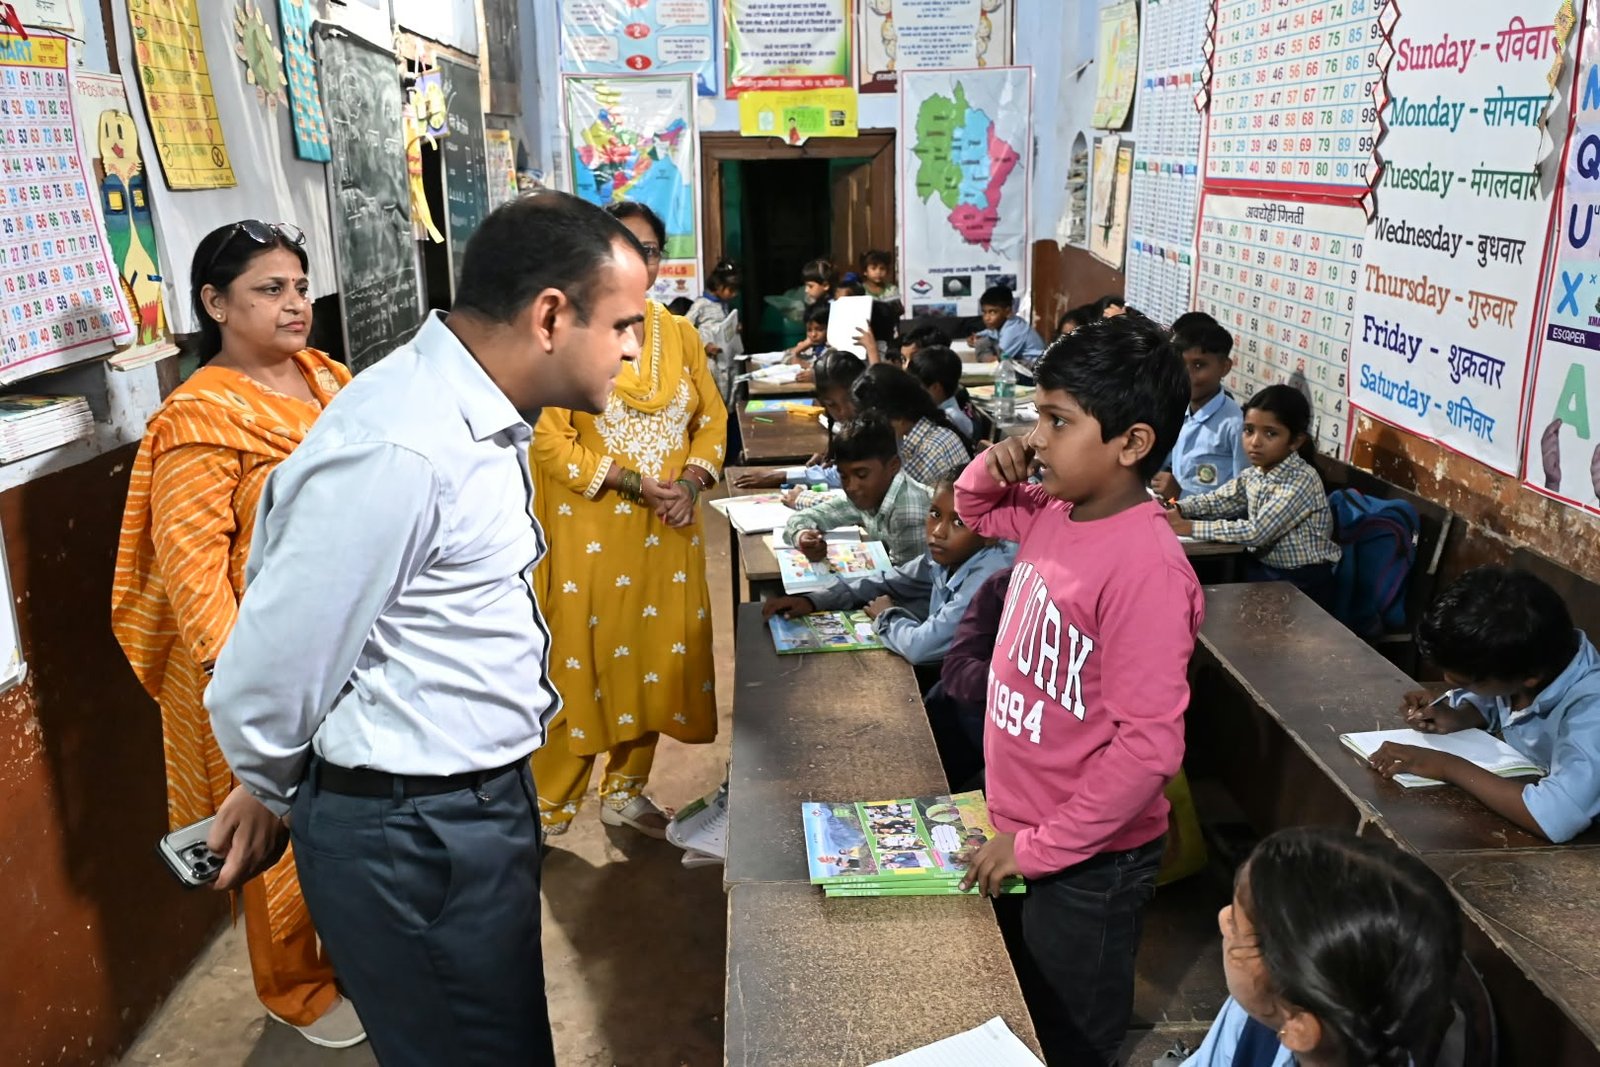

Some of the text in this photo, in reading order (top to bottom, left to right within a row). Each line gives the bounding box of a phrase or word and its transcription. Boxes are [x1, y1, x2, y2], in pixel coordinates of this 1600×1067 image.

[1277, 1, 1365, 31] 44 54 64 74 84
[1275, 28, 1362, 56] 45 55 65 75 85
[1397, 33, 1476, 74] Sunday
[635, 57, 643, 69] 3
[1273, 55, 1359, 80] 46 56 66 76 86
[21, 71, 66, 86] 61 71 81 91
[48, 100, 69, 114] 82 92
[1271, 84, 1356, 105] 47 57 67 77 87
[1269, 108, 1375, 126] 48 58 68 78 88 98
[1389, 95, 1465, 132] Monday
[18, 128, 72, 143] 53 73 93
[1251, 137, 1372, 152] 39 49 59 69 79 89 99
[13, 155, 79, 173] 44 64 74 94
[1249, 162, 1348, 176] 40 50 60 70 80 90
[30, 182, 85, 200] 55 75 95
[1383, 160, 1454, 199] Tuesday
[1471, 161, 1541, 201] मंगलवार
[3, 210, 81, 233] 26 56 66 86
[1245, 203, 1304, 225] अवरोही गिनती
[1568, 204, 1593, 249] U
[43, 235, 97, 256] 57 67 77 97
[1260, 230, 1362, 258] 60 40 30 20 10
[1375, 216, 1463, 258] Wednesday
[1477, 234, 1526, 268] बुधवार
[5, 266, 73, 293] 18 58 68
[1258, 252, 1356, 284] 59 39 29 19 9
[12, 285, 114, 320] 19 39 49 59 99
[1255, 274, 1353, 311] 58 38 28 18 8
[1365, 264, 1450, 315] Thursday
[1468, 290, 1518, 328] गुरुवार
[1557, 270, 1584, 317] X
[8, 310, 124, 352] 10 40 50 60 70 100
[1253, 296, 1350, 337] 57 37 27 17 7
[1282, 329, 1347, 362] 36 26 16 6
[1363, 314, 1422, 363] Friday
[1448, 344, 1505, 389] शुक्रवार
[1249, 340, 1345, 387] 55 35 15 5
[1247, 362, 1342, 412] 54 14 4
[1552, 362, 1590, 440] A
[1360, 364, 1431, 417] Saturday
[1446, 396, 1495, 442] शनिवार
[1332, 424, 1339, 437] 3
